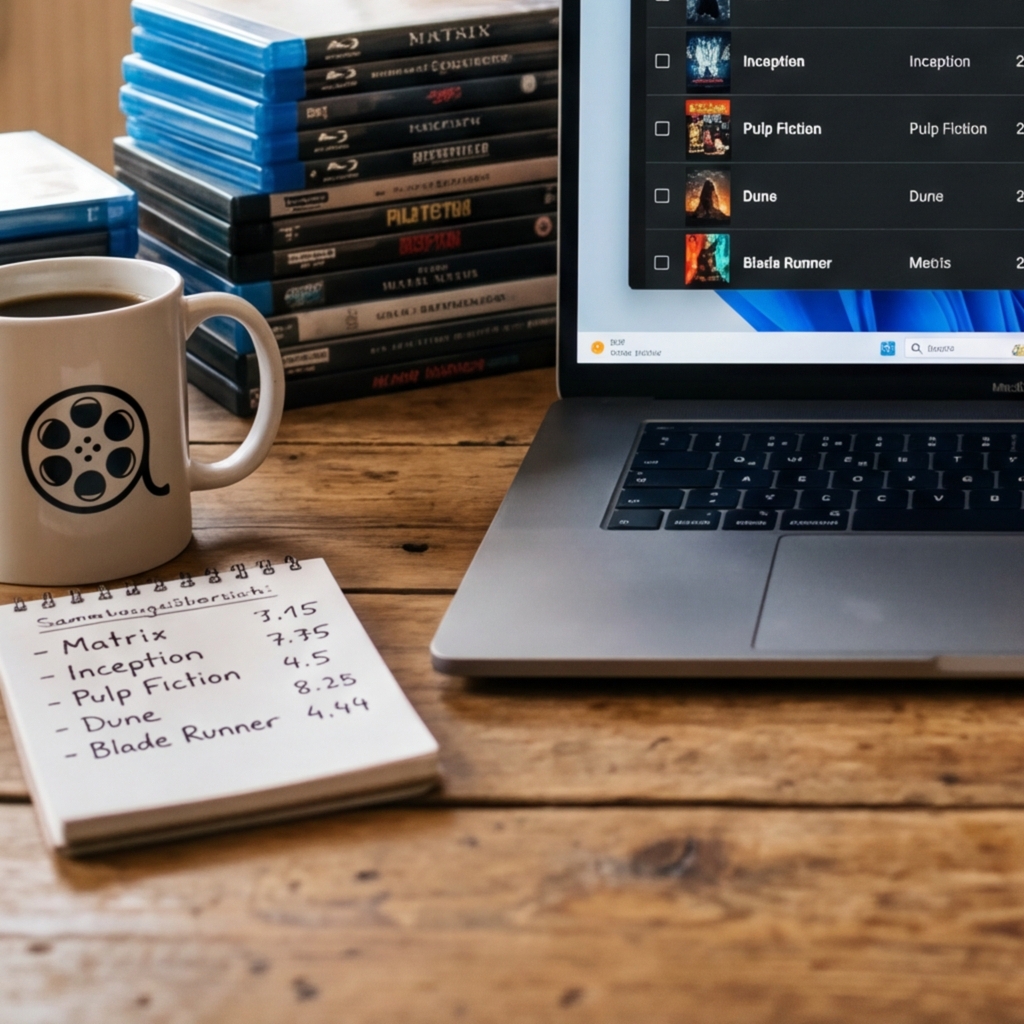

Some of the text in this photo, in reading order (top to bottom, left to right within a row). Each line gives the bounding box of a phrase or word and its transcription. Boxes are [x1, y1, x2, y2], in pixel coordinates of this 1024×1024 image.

[909, 54, 971, 71] Inception
[743, 121, 773, 138] Pulp
[909, 121, 940, 138] Pulp
[742, 189, 778, 203] Dune
[909, 189, 944, 203] Dune
[783, 256, 833, 270] Runner
[62, 628, 168, 656] Matrix
[67, 650, 204, 682] Inception
[72, 649, 331, 707] Pulp Fiction 4.5
[81, 673, 357, 734] Dune 8.25
[89, 696, 370, 760] Blade Runner 4.44
